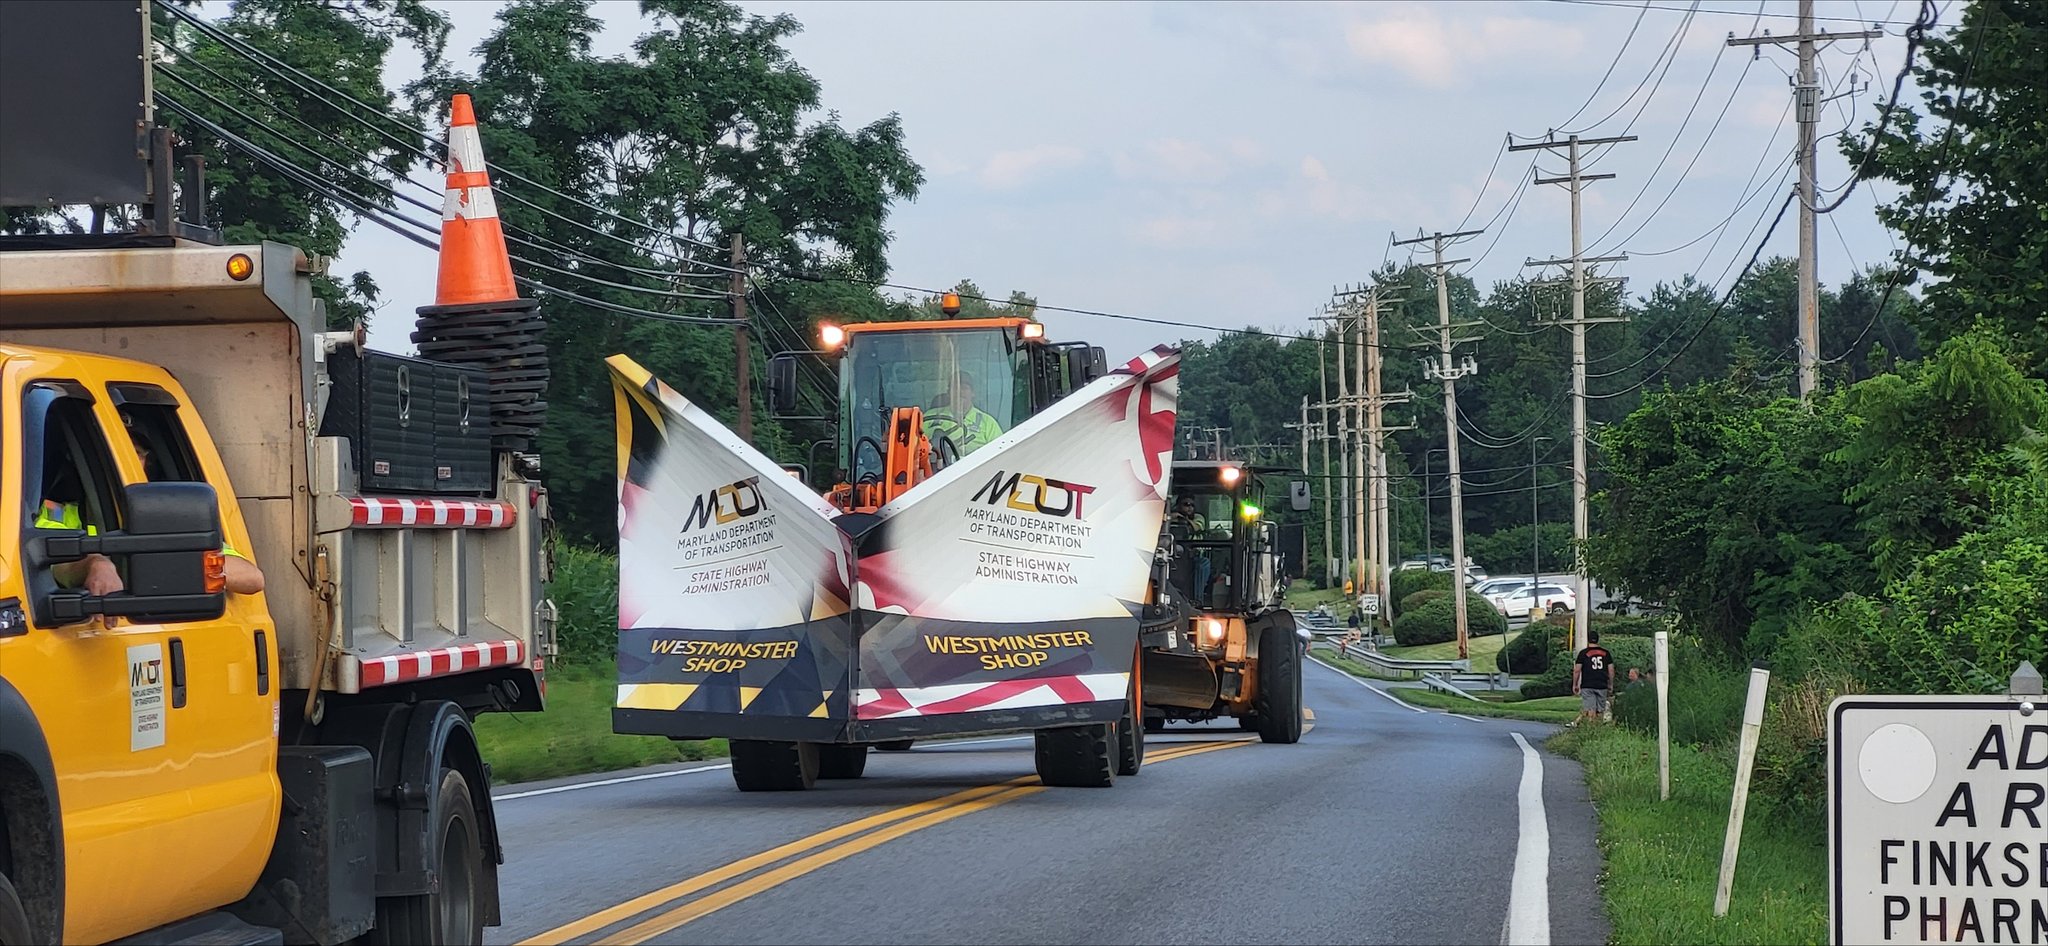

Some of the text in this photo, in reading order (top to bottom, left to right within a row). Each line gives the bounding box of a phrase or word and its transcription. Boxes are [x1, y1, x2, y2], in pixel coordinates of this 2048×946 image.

[677, 514, 777, 550] MARYLAND DEPARTMENT
[964, 507, 1092, 537] MARYLAND DEPARTMENT
[684, 530, 775, 561] OF TRANSPORTATION
[969, 522, 1082, 549] OF TRANSPORTATION
[690, 559, 768, 583] STATE HIGHWAY
[979, 551, 1071, 573] STATE HIGHWAY
[682, 573, 770, 595] ADMINISTRATION
[975, 565, 1079, 585] ADMINISTRATION
[1364, 604, 1377, 612] 40
[650, 639, 799, 660] WESTMINSTER
[924, 630, 1094, 655] WESTMINSTER
[681, 657, 747, 674] SHOP
[979, 651, 1049, 671] SHOP
[1591, 656, 1603, 669] 35
[1966, 724, 2048, 771] AD
[1935, 782, 2046, 829] A R
